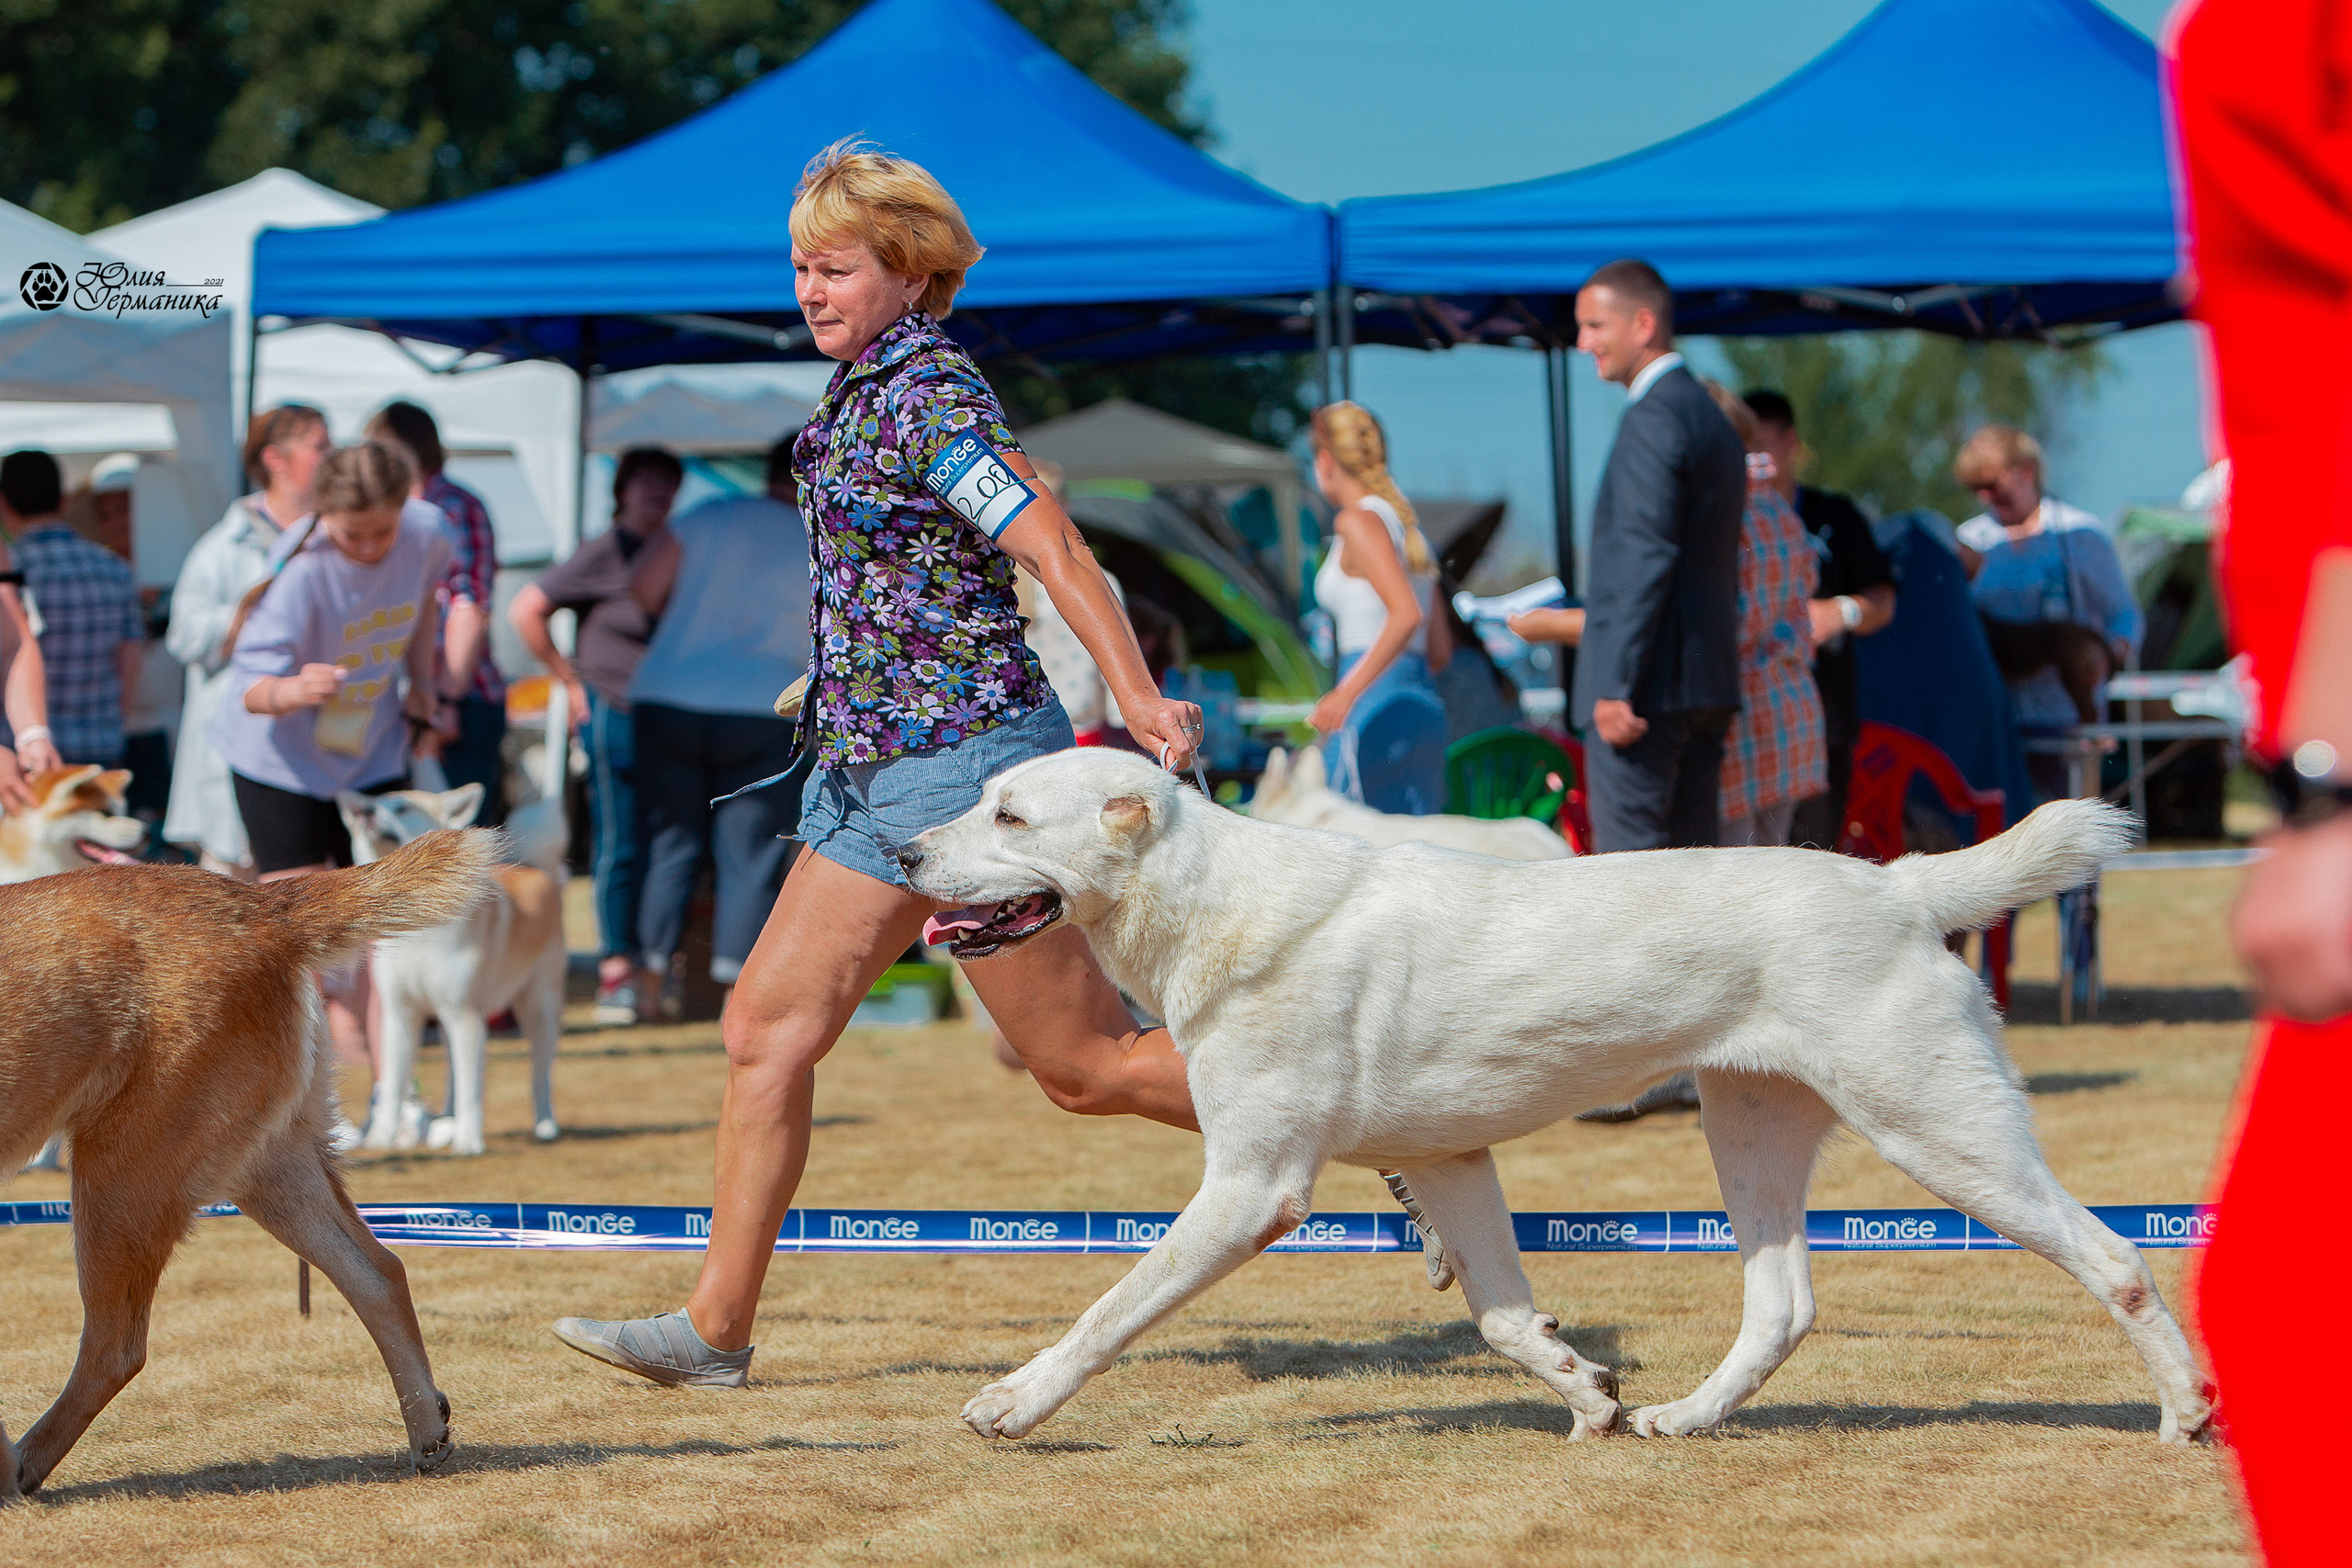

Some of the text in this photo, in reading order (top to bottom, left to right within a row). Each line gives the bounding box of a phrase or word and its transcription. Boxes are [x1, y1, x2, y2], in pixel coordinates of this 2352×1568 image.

[950, 447, 984, 480] Superpremium
[1843, 1240, 1937, 1249] Natural Superpremium
[2145, 1236, 2177, 1245] Natural
[1577, 1243, 1638, 1251] Superpremium
